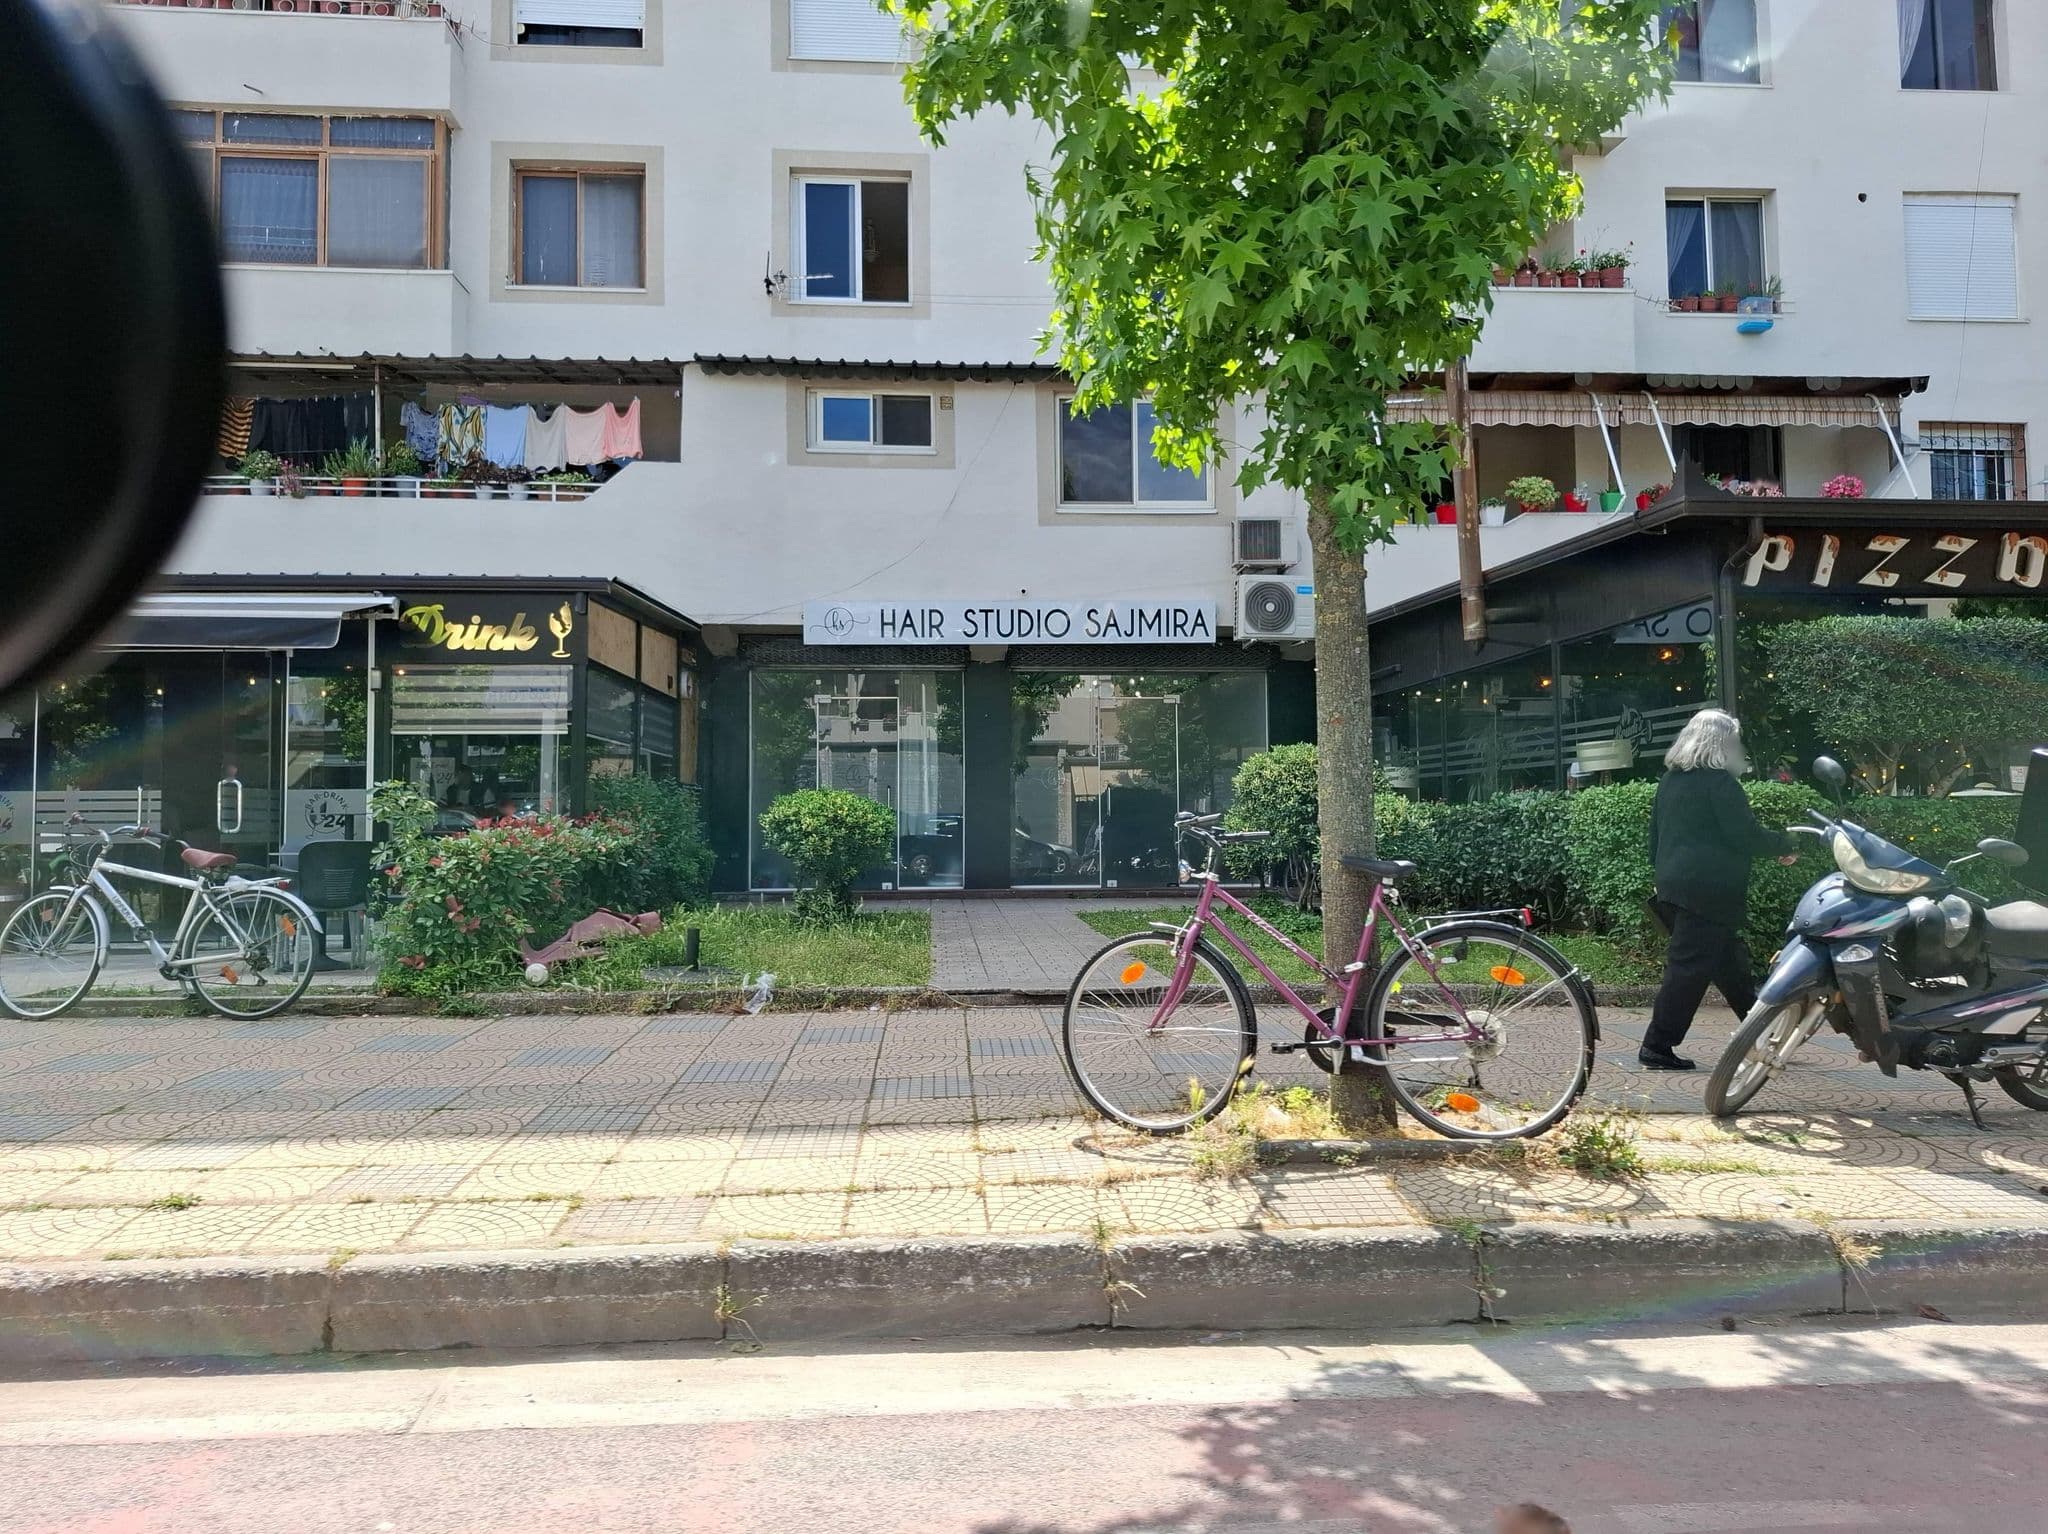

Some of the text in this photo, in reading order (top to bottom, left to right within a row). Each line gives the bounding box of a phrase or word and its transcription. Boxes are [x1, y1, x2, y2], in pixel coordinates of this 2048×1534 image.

[400, 604, 539, 651] Drink
[880, 608, 1210, 639] HAIR STUDIO SAJMIRA
[323, 814, 346, 828] 24
